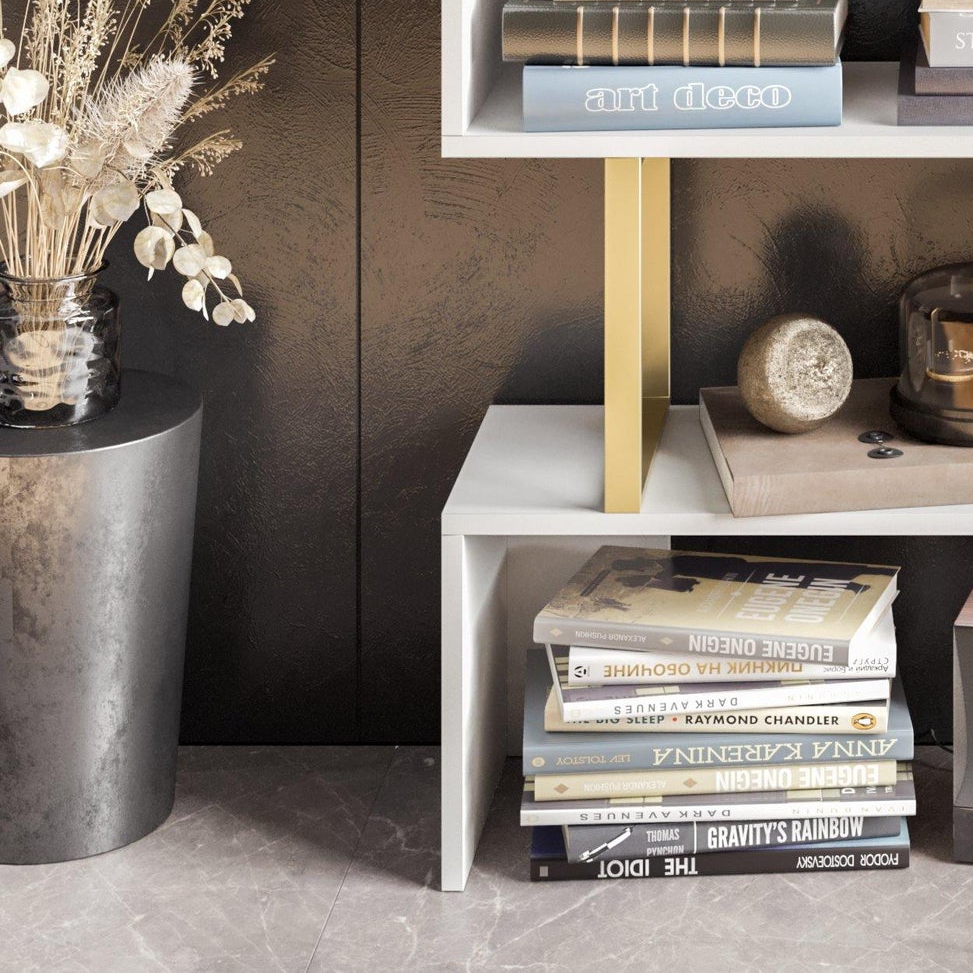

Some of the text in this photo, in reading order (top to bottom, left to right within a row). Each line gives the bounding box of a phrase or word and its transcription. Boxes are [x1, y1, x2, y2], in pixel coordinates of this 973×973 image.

[585, 82, 792, 112] art deco
[736, 572, 806, 621] EUGENE
[783, 577, 851, 624] ONEGIN
[575, 630, 834, 662] EUGENE ONEGIN ALEXANDR PUSHKIN
[604, 660, 803, 678] ПИКНИК НА ОБОЧИНЕ
[823, 666, 846, 674] Борис
[856, 665, 889, 673] Аркадий
[614, 697, 738, 715] DARK AVENUES
[626, 715, 665, 725] SLEEP
[685, 715, 758, 726] RAYMOND
[764, 715, 840, 726] CHANDLER
[556, 738, 898, 766] ANNA KARENINA LEV TOLSTOY
[715, 768, 792, 792] ONEGIN
[799, 764, 880, 788] EUGENE
[580, 810, 671, 821] AVENUES
[679, 809, 731, 819] DARK
[646, 828, 680, 842] THOMAS
[707, 816, 864, 850] GRAVITY'S RAINBOW
[646, 845, 685, 857] PYNCHON
[598, 853, 899, 879] FYODOR DOSTOEVSKY THE IDIOT
